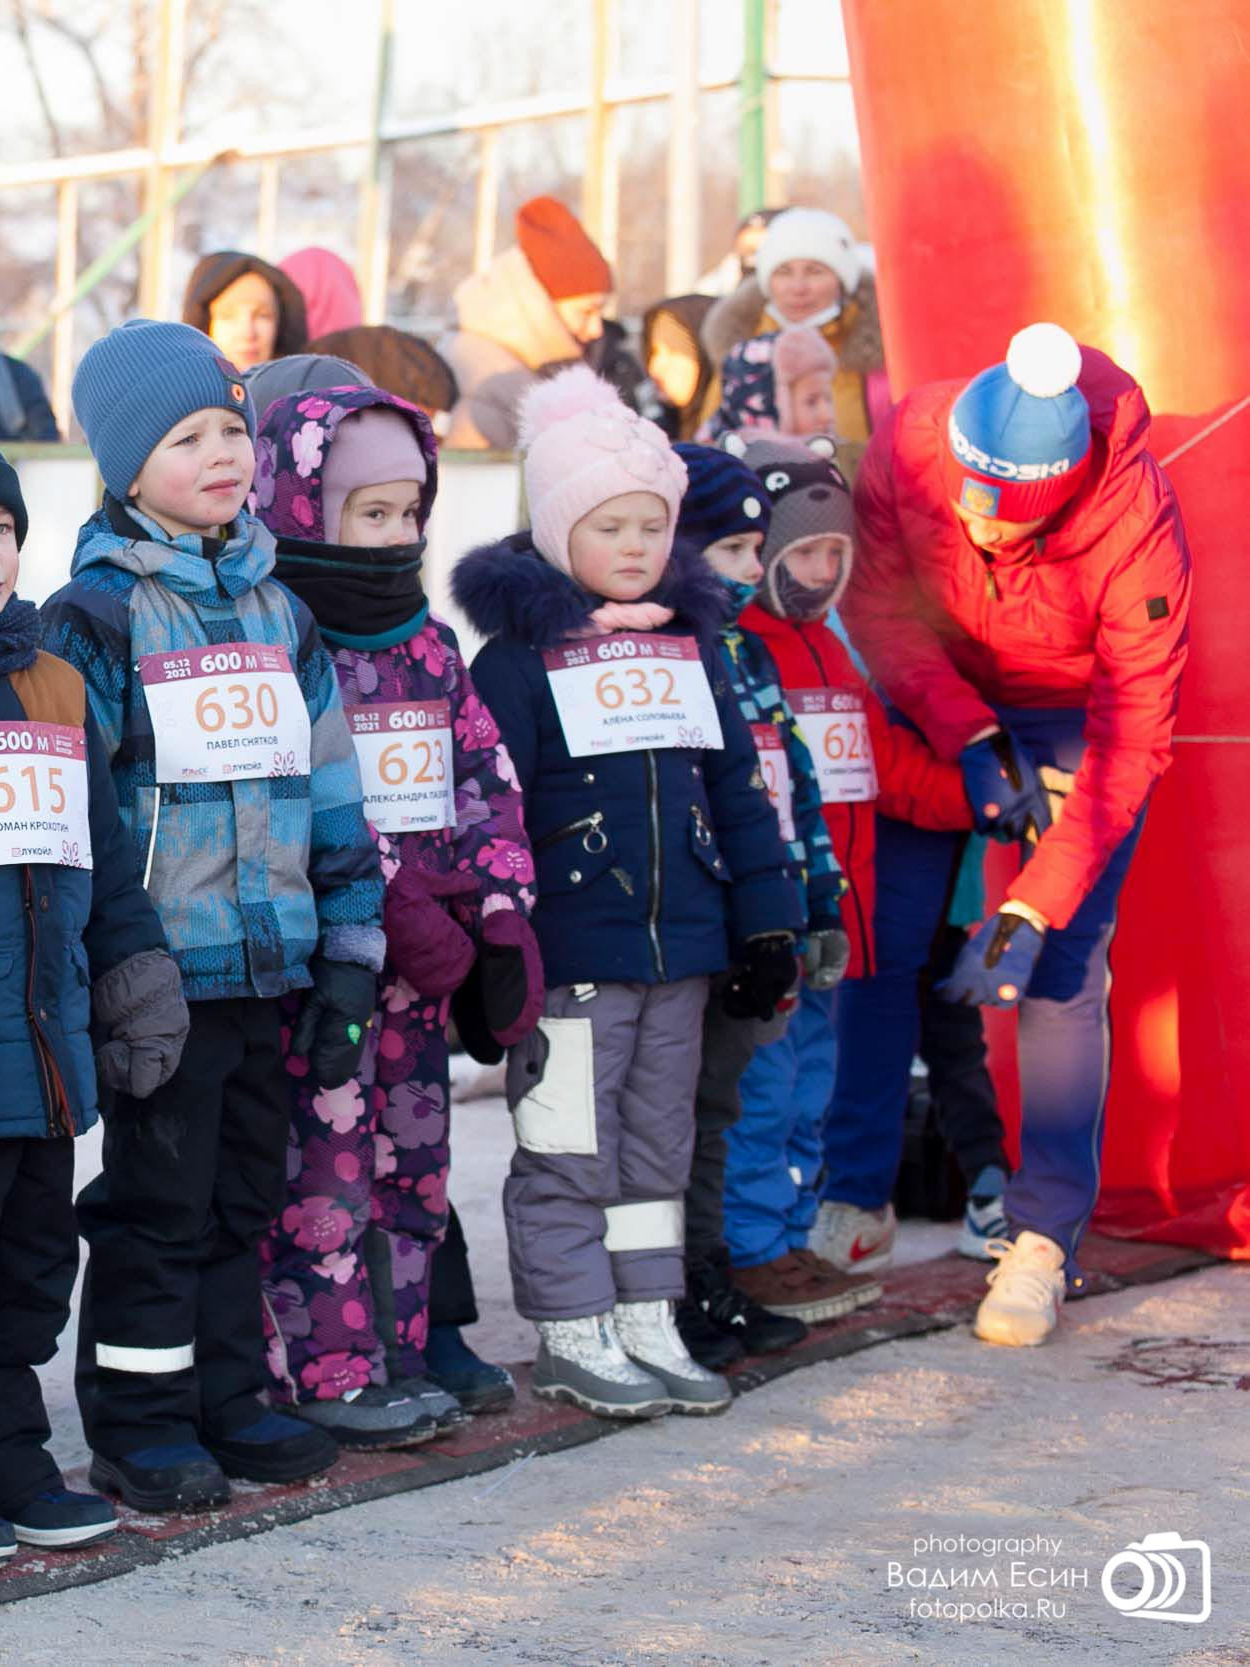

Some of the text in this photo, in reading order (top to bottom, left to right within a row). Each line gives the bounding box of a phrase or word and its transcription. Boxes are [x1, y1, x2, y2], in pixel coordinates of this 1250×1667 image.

[597, 640, 636, 660] 600
[163, 658, 190, 670] 05.12
[200, 652, 242, 673] 600
[165, 668, 191, 679] 2021
[595, 668, 681, 710] 632
[195, 683, 278, 733] 630
[389, 710, 426, 729] 600
[206, 737, 240, 751] ПАВЕЛ
[378, 739, 446, 786] 623
